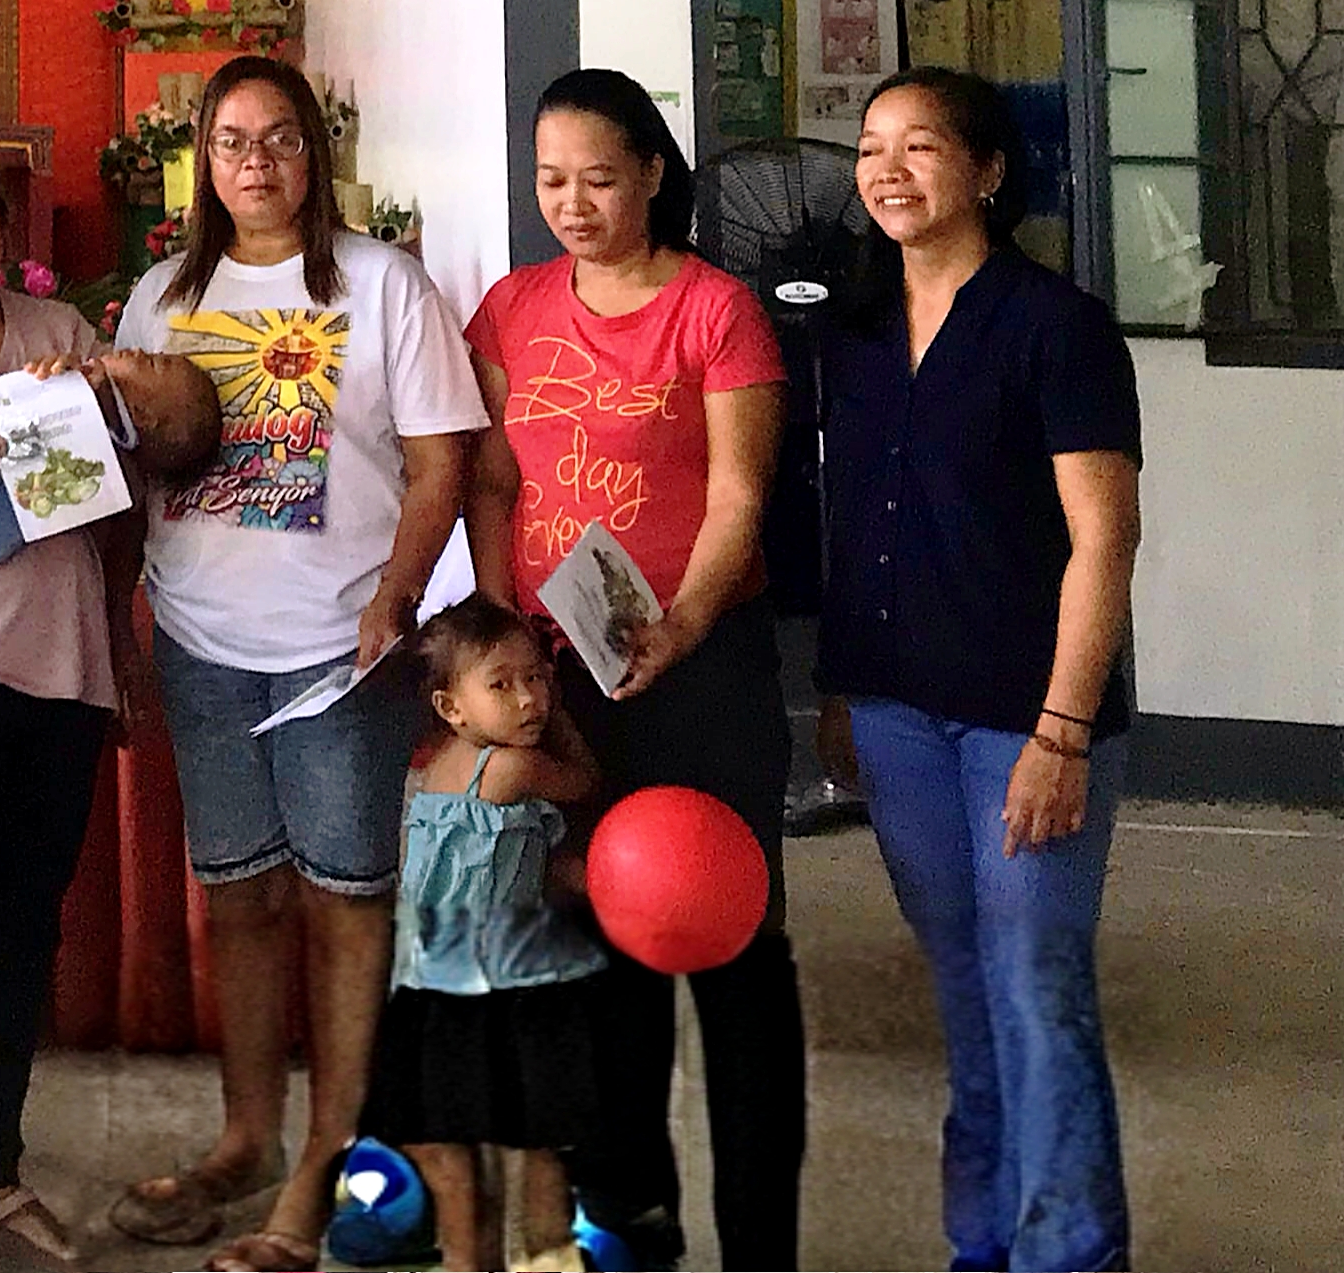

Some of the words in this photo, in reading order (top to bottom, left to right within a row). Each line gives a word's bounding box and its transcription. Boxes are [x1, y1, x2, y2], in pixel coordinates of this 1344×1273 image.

[504, 336, 682, 425] Best
[206, 475, 317, 517] Senyor
[556, 424, 649, 532] day
